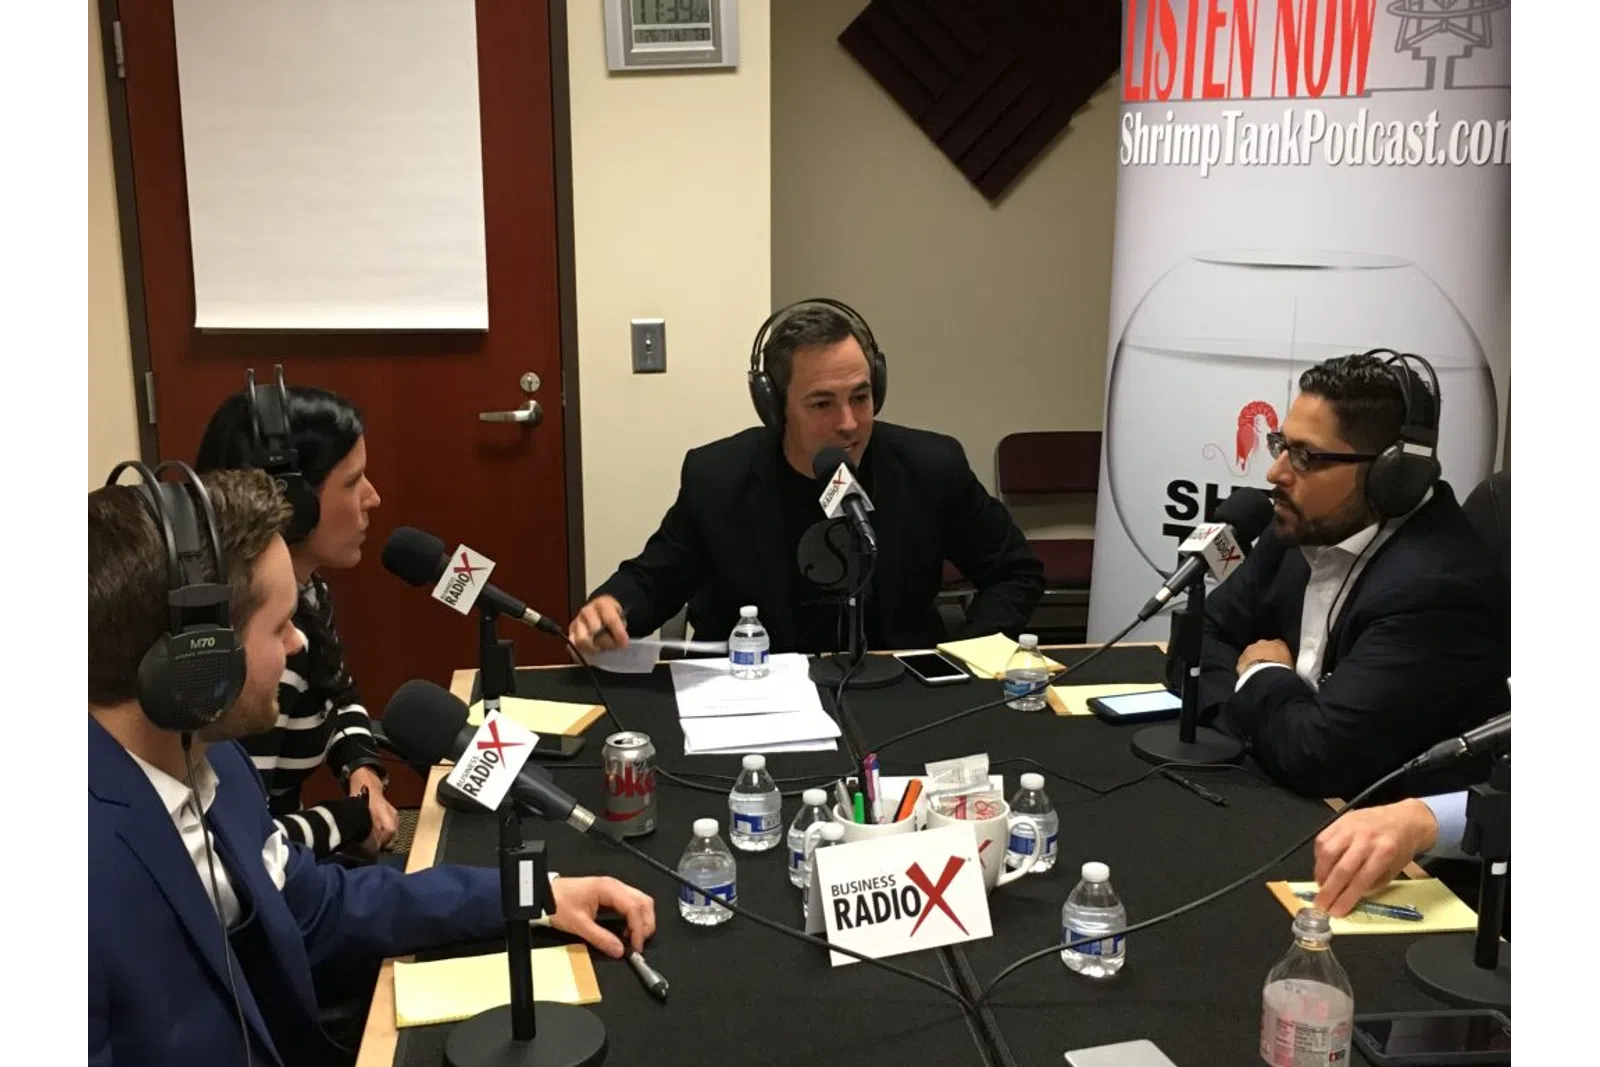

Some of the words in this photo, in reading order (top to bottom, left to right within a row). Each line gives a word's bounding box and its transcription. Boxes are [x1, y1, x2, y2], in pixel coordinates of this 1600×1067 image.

[1122, 0, 1258, 103] LISTEN
[1271, 0, 1376, 100] NOW
[190, 637, 216, 649] M70
[831, 874, 896, 898] BUSINESS
